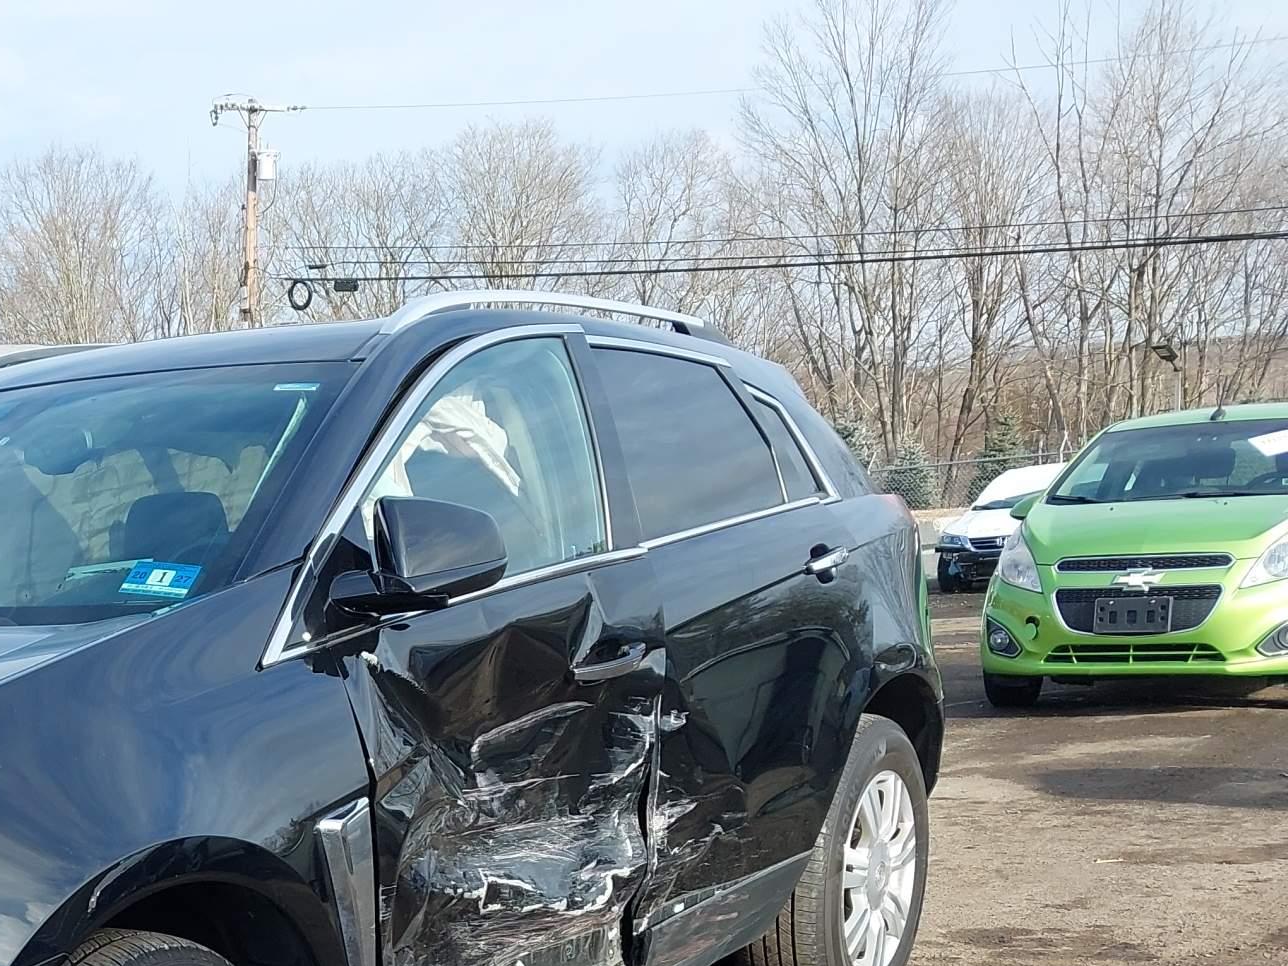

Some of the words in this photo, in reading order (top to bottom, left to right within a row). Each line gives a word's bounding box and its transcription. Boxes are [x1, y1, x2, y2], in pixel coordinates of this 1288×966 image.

[131, 571, 148, 580] 20
[156, 571, 169, 583] 1
[174, 575, 193, 585] 27
